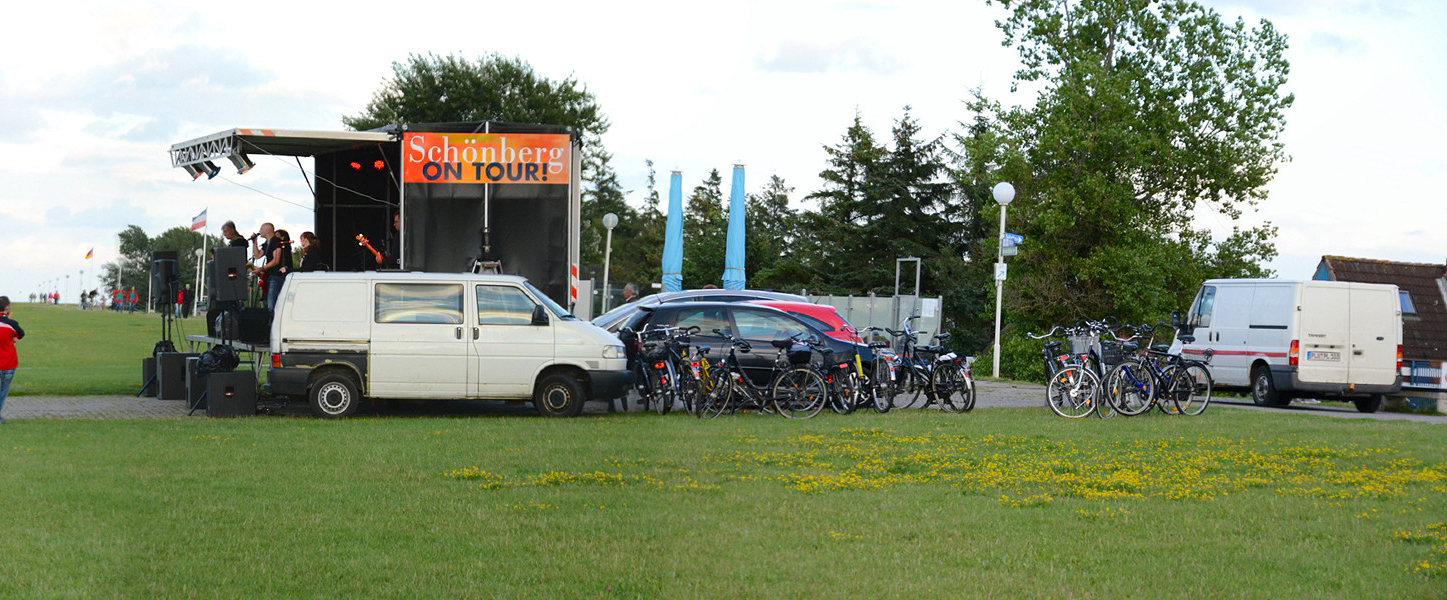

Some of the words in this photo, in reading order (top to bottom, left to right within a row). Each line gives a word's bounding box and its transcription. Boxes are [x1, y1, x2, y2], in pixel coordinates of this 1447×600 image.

[409, 135, 564, 175] Schönberg
[422, 161, 463, 181] ON
[472, 161, 548, 181] TOUR!
